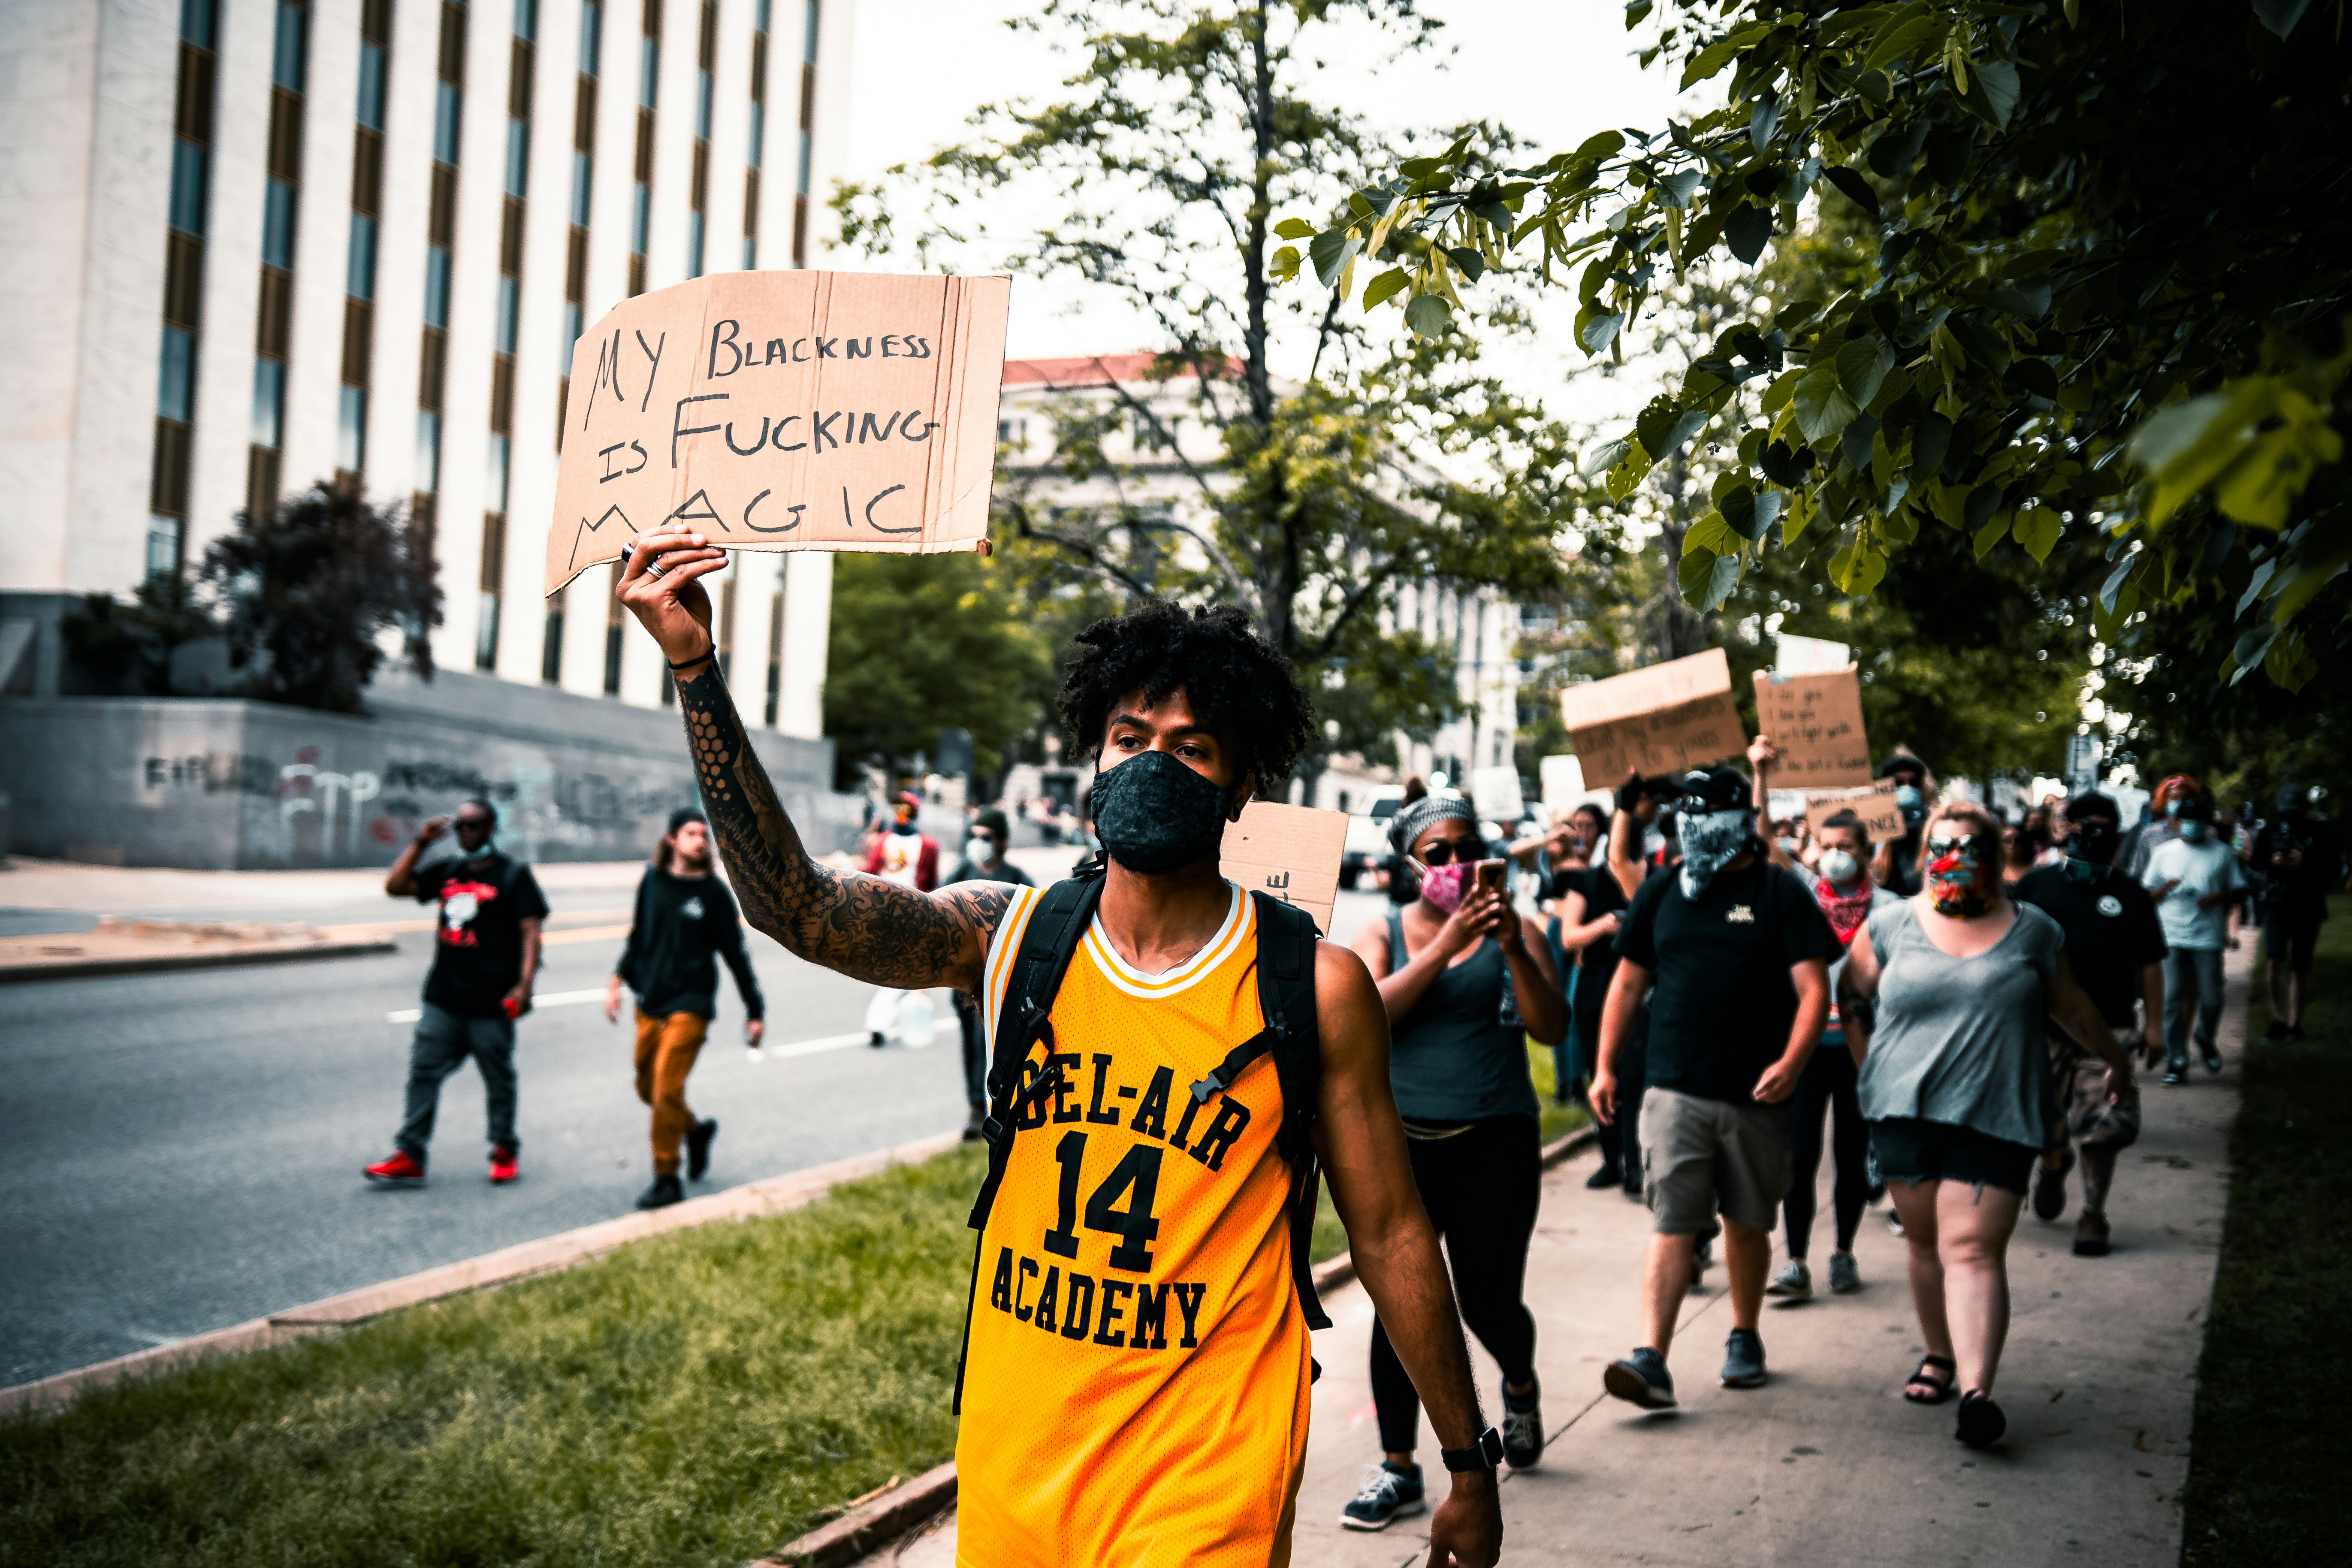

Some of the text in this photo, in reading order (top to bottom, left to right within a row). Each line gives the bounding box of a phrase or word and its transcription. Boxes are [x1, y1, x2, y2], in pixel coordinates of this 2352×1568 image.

[584, 319, 930, 431] MY BLACKNESS
[599, 393, 940, 483] IS FUCKING
[569, 484, 922, 570] MAGIC
[1017, 1053, 1251, 1172] BEL-AIR
[1043, 1130, 1164, 1273] 14
[991, 1247, 1206, 1350] ACADEMY
